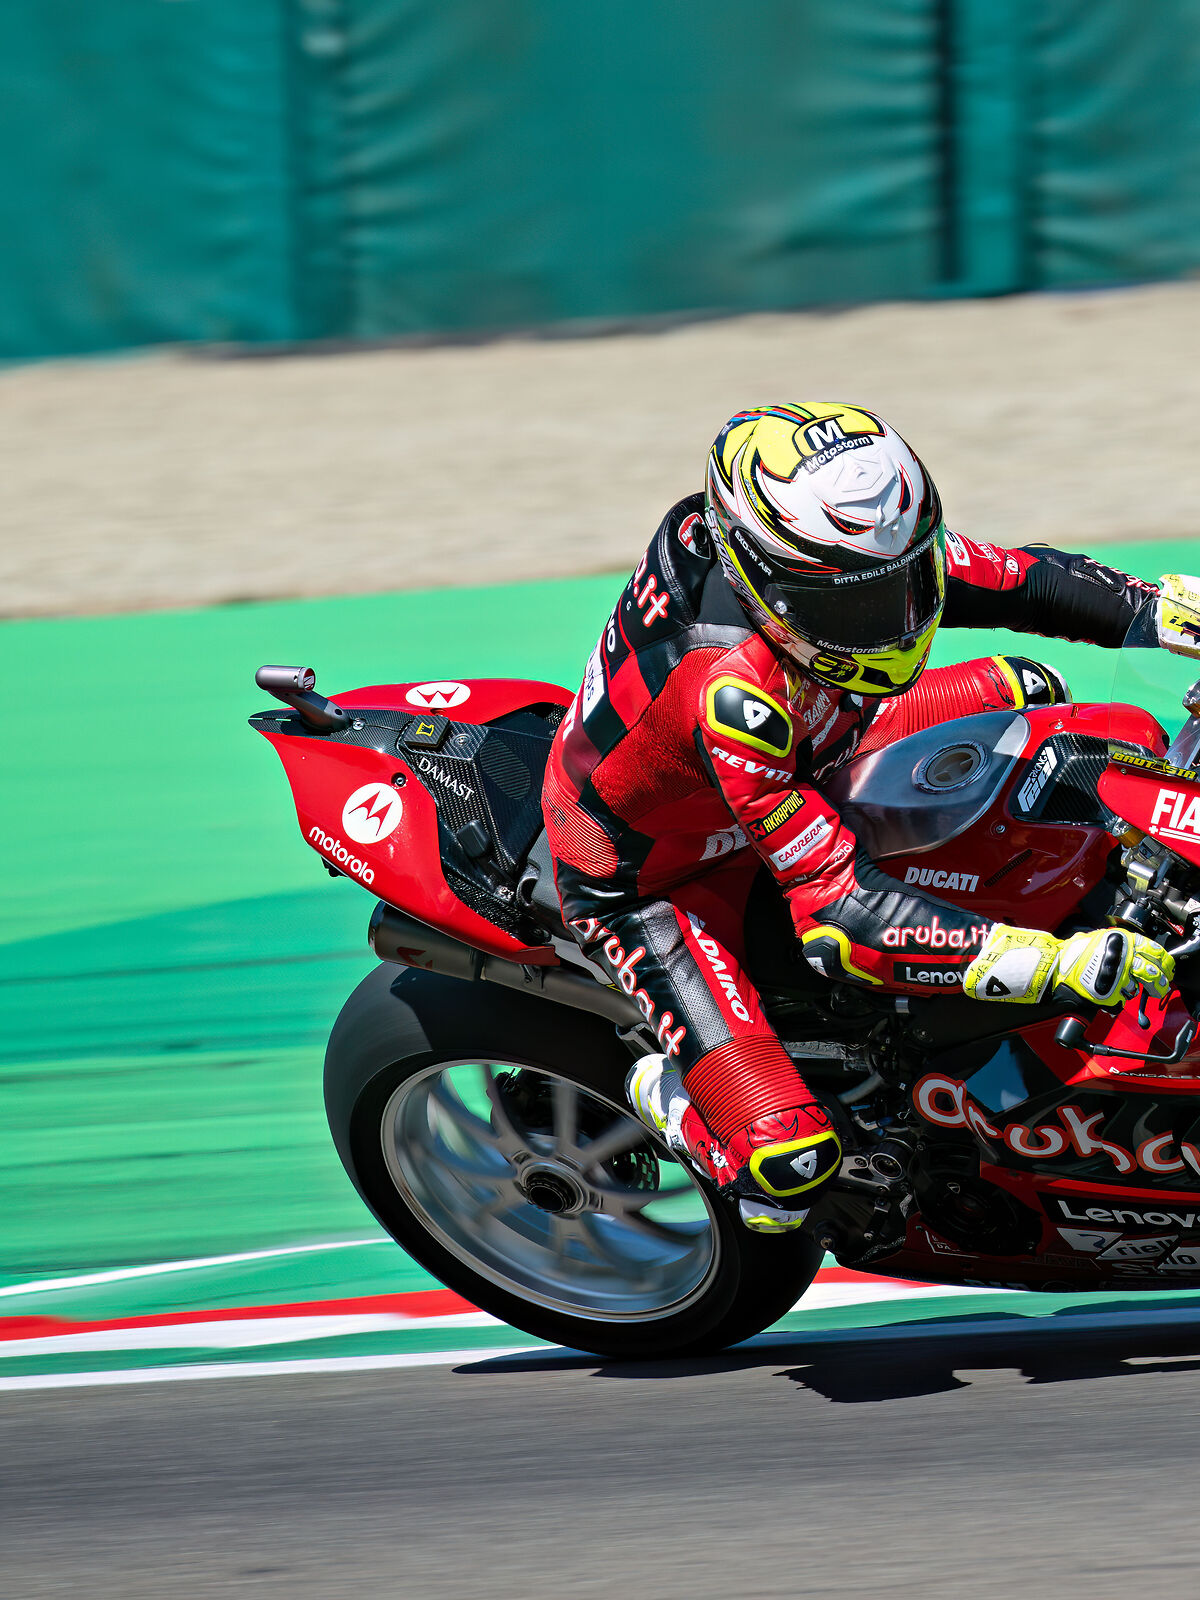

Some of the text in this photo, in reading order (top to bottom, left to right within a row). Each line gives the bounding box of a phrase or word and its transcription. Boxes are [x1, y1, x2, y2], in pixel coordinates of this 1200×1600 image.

[807, 420, 847, 451] M
[804, 435, 871, 476] Motostorm
[757, 561, 772, 577] AIR
[833, 575, 860, 585] DITTA
[861, 567, 886, 580] EDILE
[887, 552, 915, 572] BALDINI
[817, 640, 888, 654] Motostorm.it
[418, 757, 475, 801] DAMAST
[711, 746, 793, 783] REV'IT!
[309, 826, 375, 885] motorola
[778, 824, 822, 863] CARRERA
[904, 867, 980, 892] DUCATI
[883, 917, 992, 948] aruba.it
[905, 967, 968, 984] Lenov
